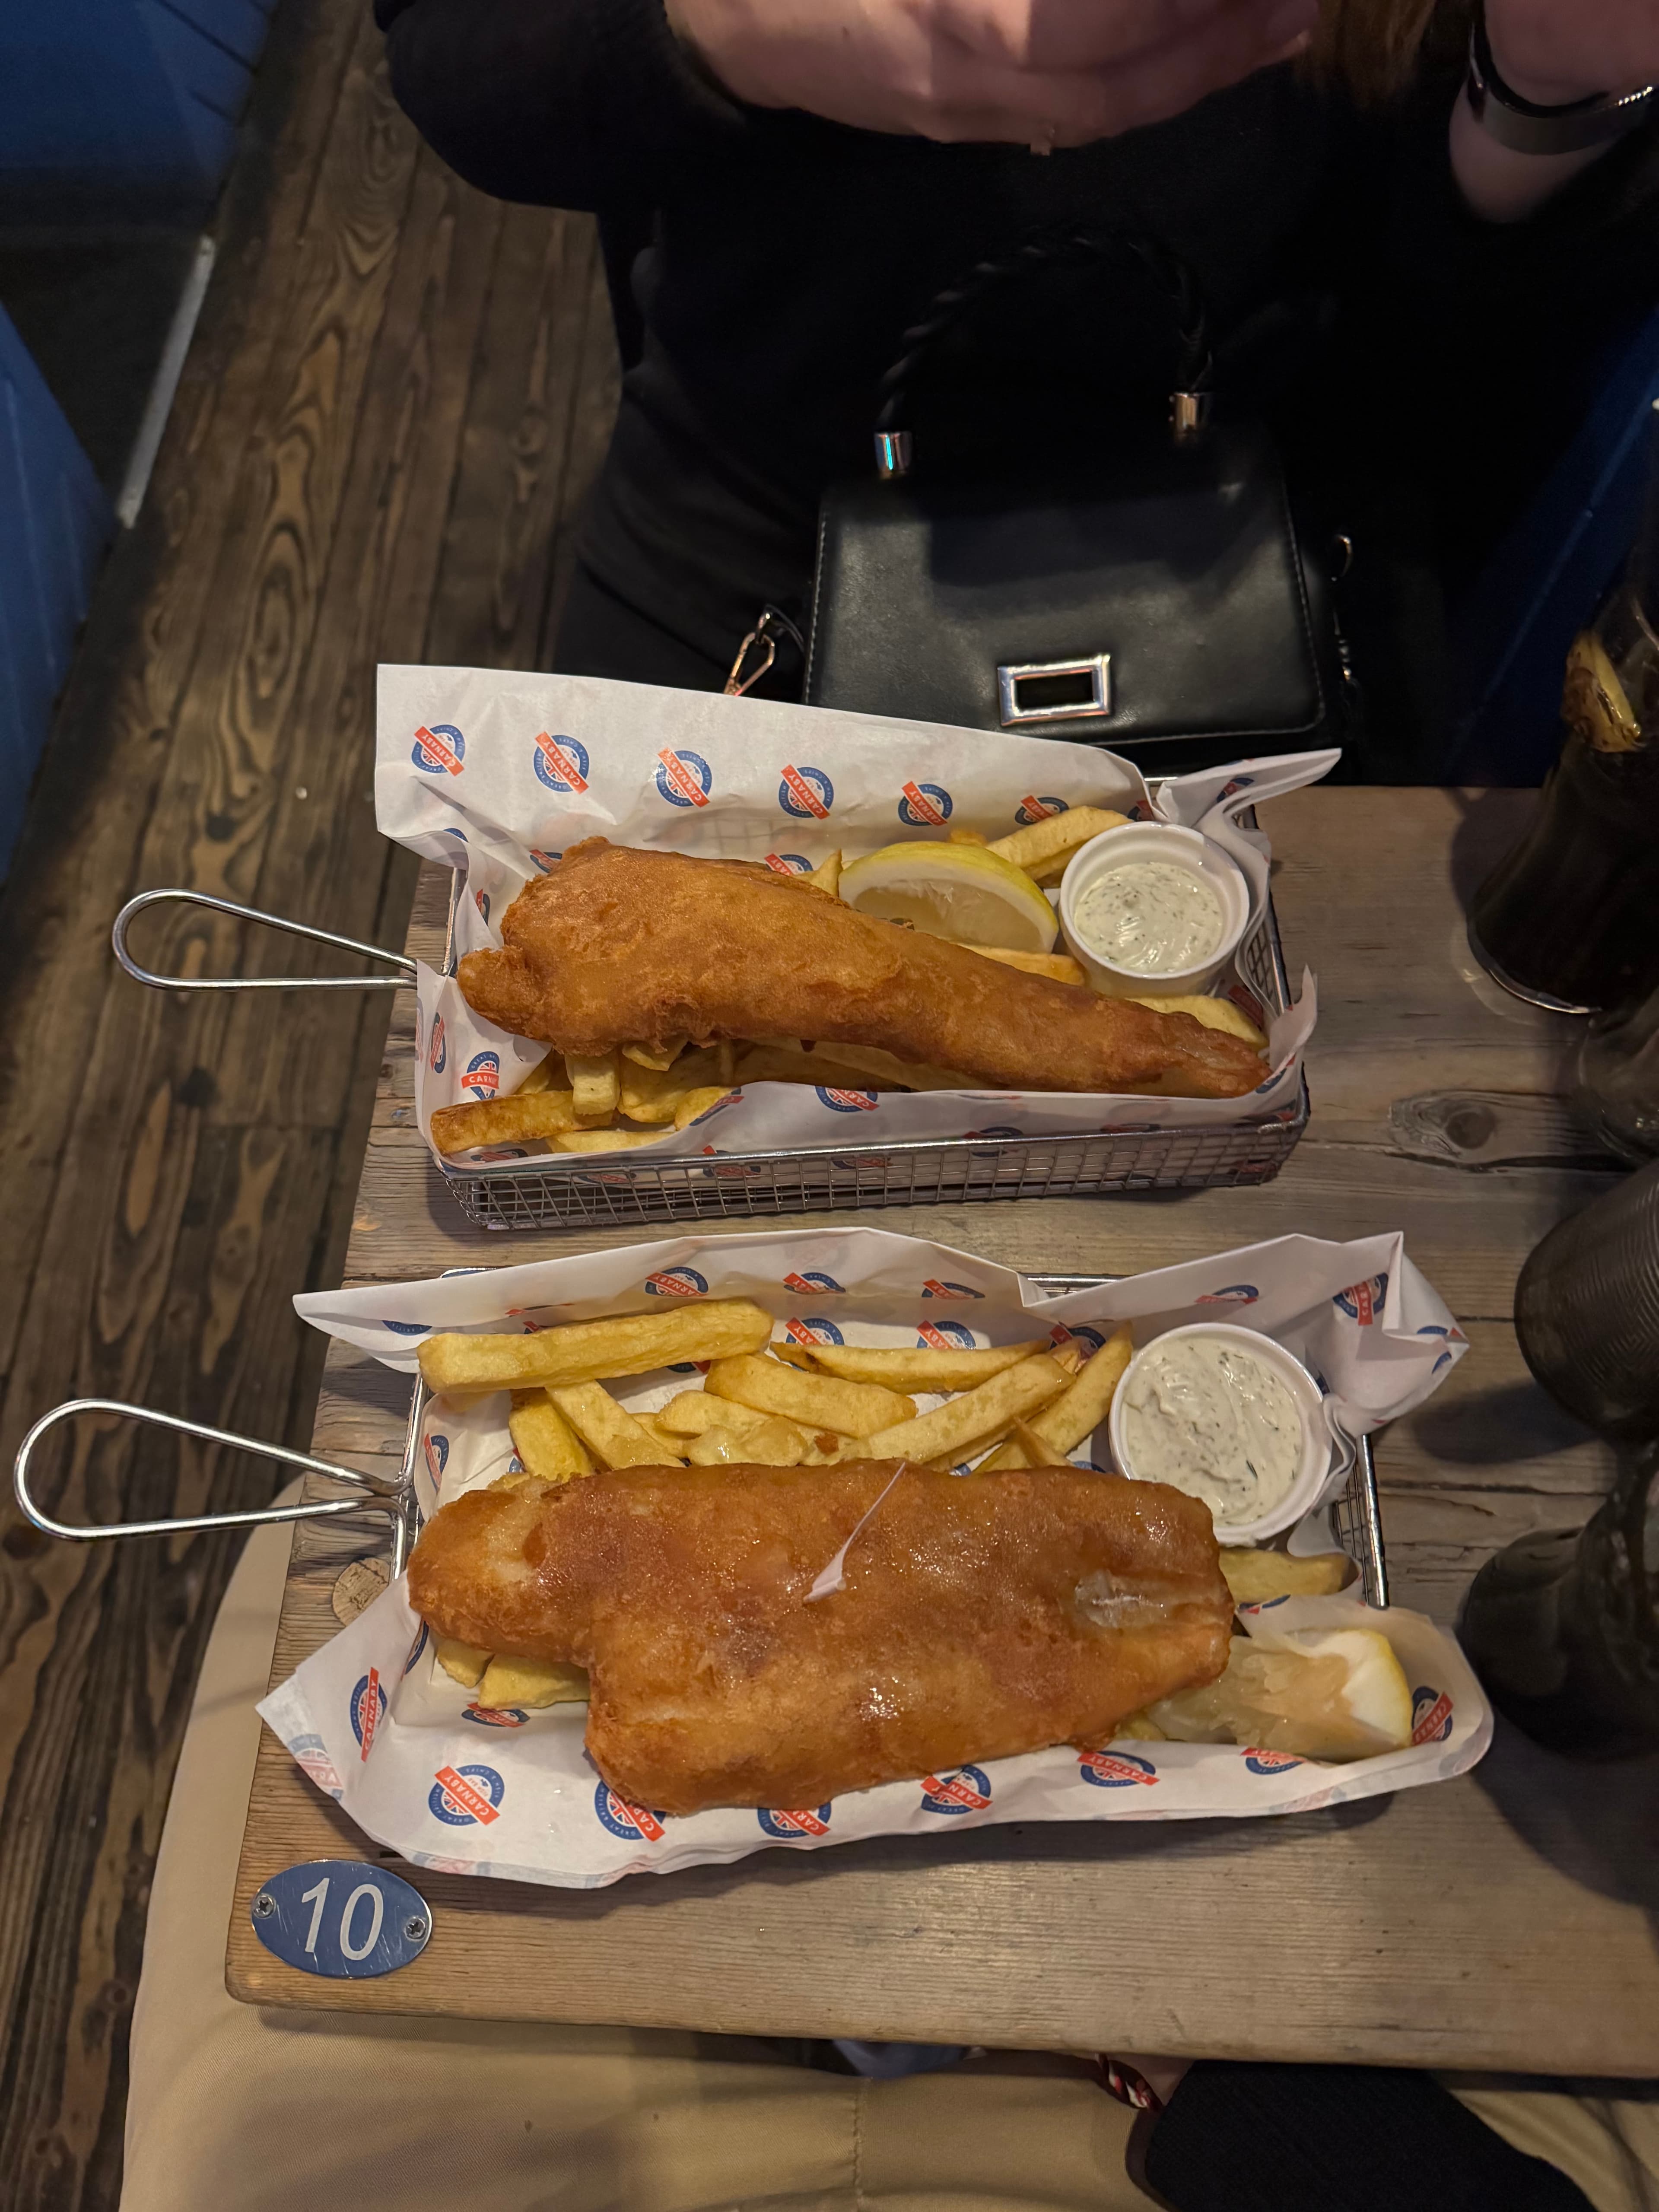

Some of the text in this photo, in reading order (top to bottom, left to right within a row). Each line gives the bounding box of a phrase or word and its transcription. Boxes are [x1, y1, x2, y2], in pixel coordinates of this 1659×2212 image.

[421, 734, 455, 766] CARNABY
[543, 741, 580, 785] CARNABY
[665, 755, 702, 801] CARNABY
[788, 774, 823, 814] CARNABY
[908, 791, 941, 823] CARNABY
[469, 1074, 497, 1084] CARN
[654, 1275, 696, 1295] ARNABY
[365, 1681, 377, 1750] CARNABY
[1088, 1755, 1147, 1780] CARNABY
[443, 1775, 489, 1816] CARNABY
[609, 1824, 636, 1837] GREAT
[301, 1877, 384, 1961] 10
